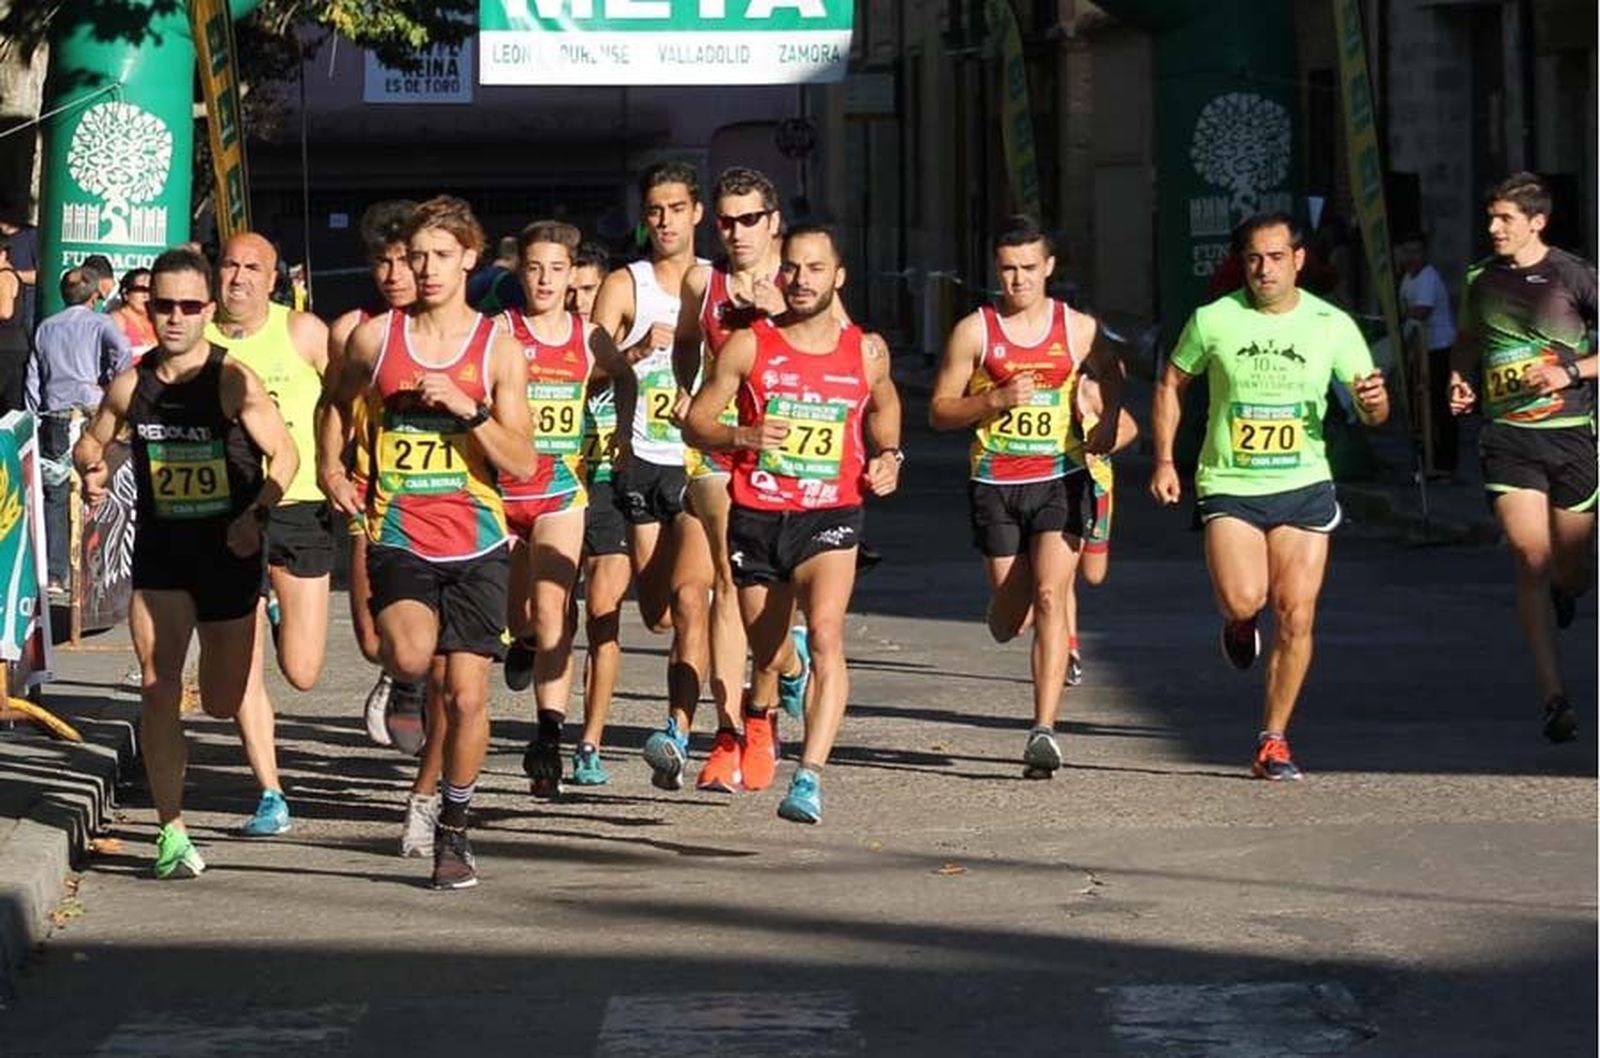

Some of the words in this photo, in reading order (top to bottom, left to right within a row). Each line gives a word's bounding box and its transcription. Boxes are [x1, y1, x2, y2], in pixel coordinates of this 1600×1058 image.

[658, 44, 750, 64] VALLADOLID
[778, 43, 841, 63] ZAMORA
[384, 78, 401, 93] ES
[424, 78, 460, 93] TORO
[1253, 357, 1270, 371] 10
[539, 405, 574, 433] 69
[998, 410, 1051, 437] 268
[1240, 424, 1294, 451] 270
[395, 440, 452, 470] 271
[157, 466, 217, 496] 279
